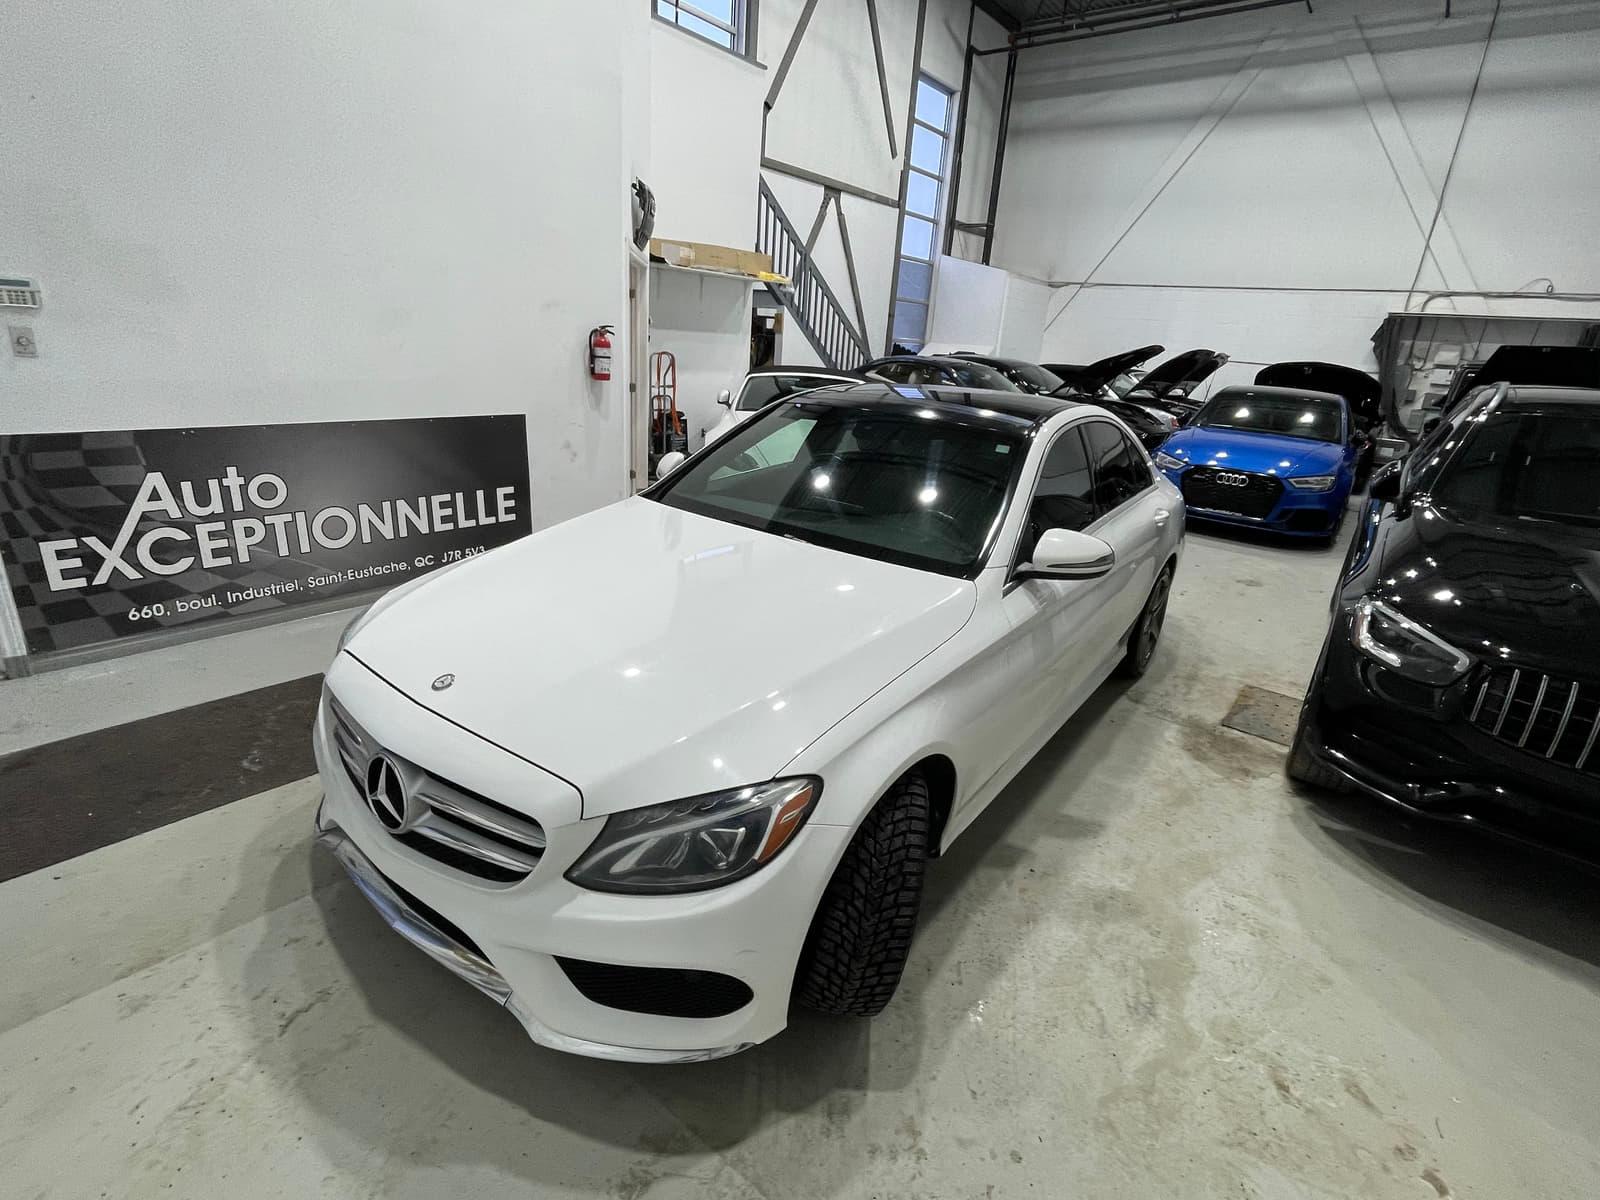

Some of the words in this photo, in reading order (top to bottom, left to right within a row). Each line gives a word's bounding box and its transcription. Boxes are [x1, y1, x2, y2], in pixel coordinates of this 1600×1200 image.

[134, 466, 288, 520] Auto
[38, 486, 518, 592] EXCEPTIONNELLE
[128, 603, 171, 621] 660,
[175, 593, 222, 613] boul.
[227, 579, 304, 604] Industriel,
[307, 560, 411, 588] Saint-Eustache,
[414, 554, 435, 568] QC
[441, 550, 462, 563] J7R
